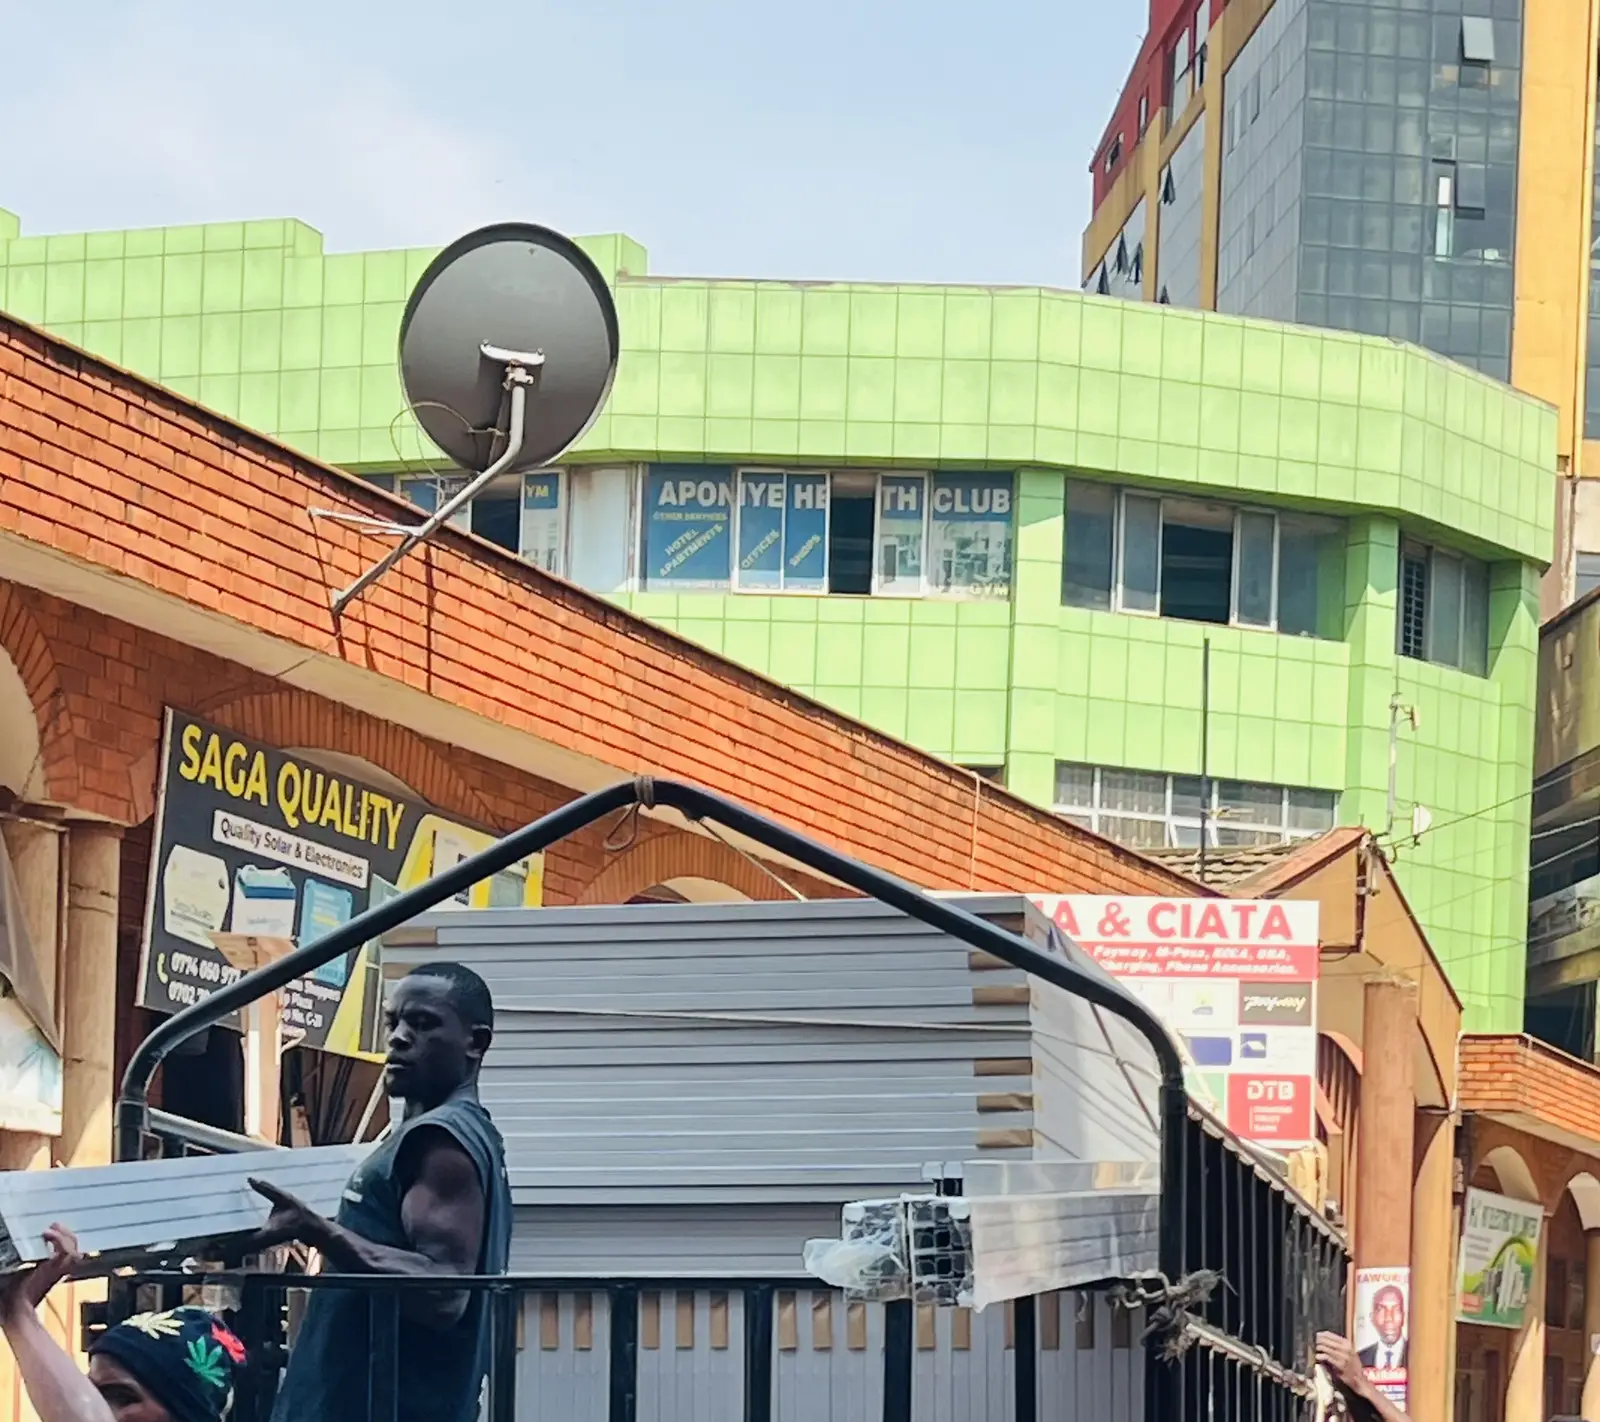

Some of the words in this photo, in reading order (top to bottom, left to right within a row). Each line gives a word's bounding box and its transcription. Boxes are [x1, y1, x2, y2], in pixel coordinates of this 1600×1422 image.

[794, 483, 917, 511] HETH
[934, 487, 1010, 514] CLUB
[179, 723, 268, 807] SAGA
[277, 761, 405, 851] QUALITY
[221, 817, 262, 848] Quality
[264, 833, 292, 853] Solar
[305, 845, 363, 879] Electronics
[1097, 901, 1131, 937] &
[1147, 902, 1293, 940] CIATA
[1247, 1080, 1294, 1100] DTB
